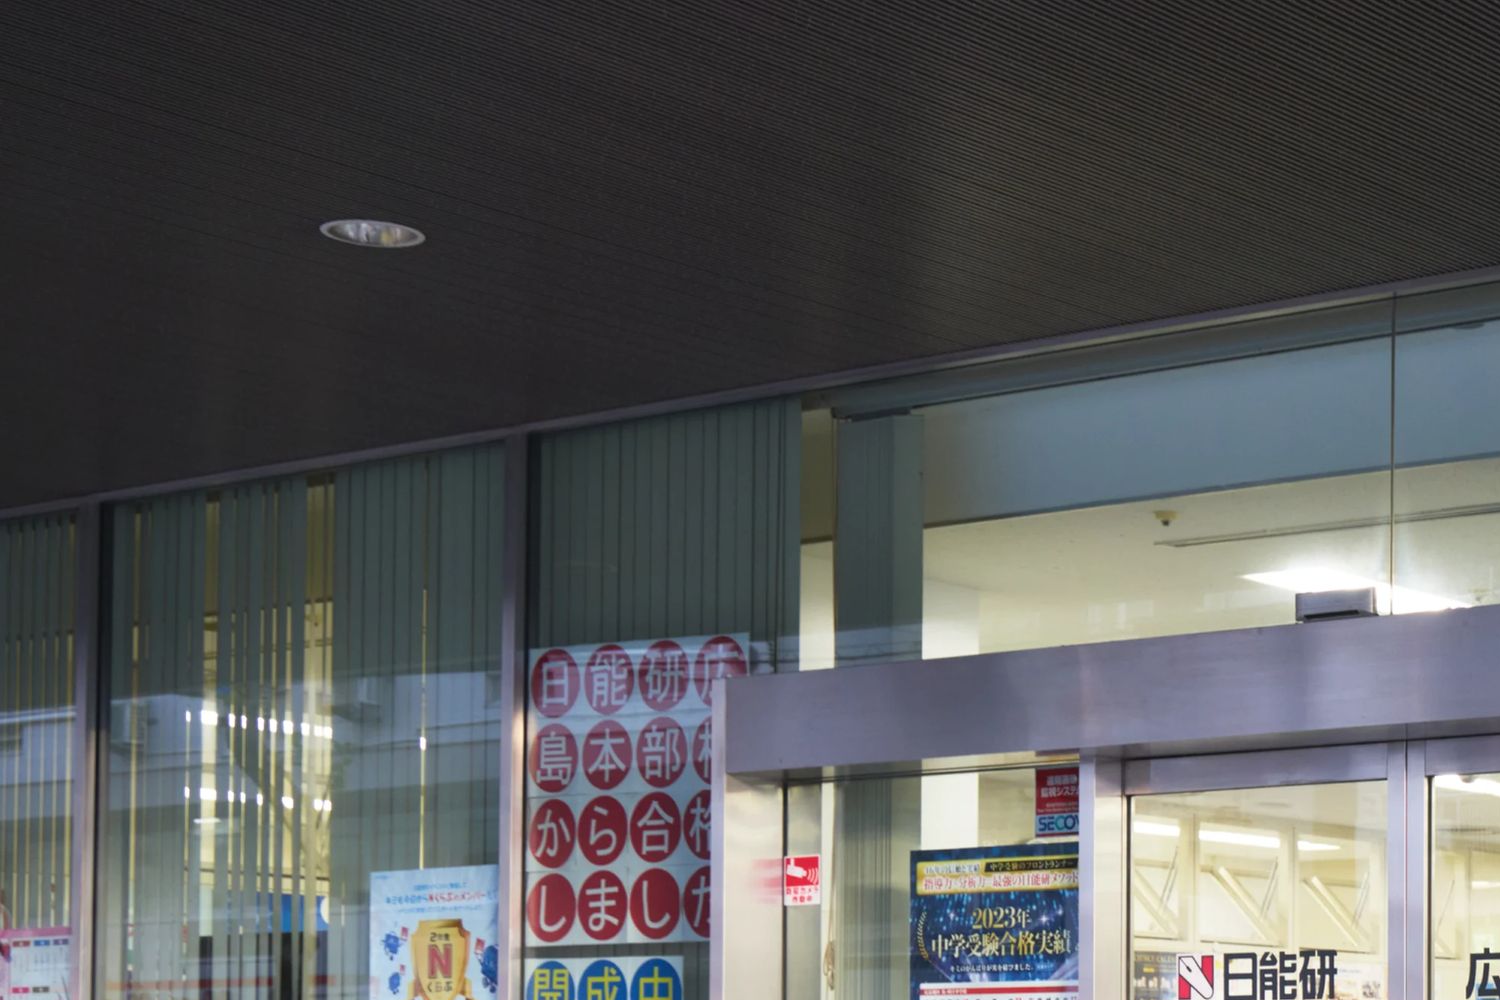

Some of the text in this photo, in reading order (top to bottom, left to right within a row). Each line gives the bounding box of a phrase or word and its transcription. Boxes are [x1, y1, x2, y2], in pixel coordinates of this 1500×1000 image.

[971, 906, 1032, 930] 2023年
[931, 929, 1072, 959] 中学受験合格実績
[1223, 950, 1338, 1000] 日能研
